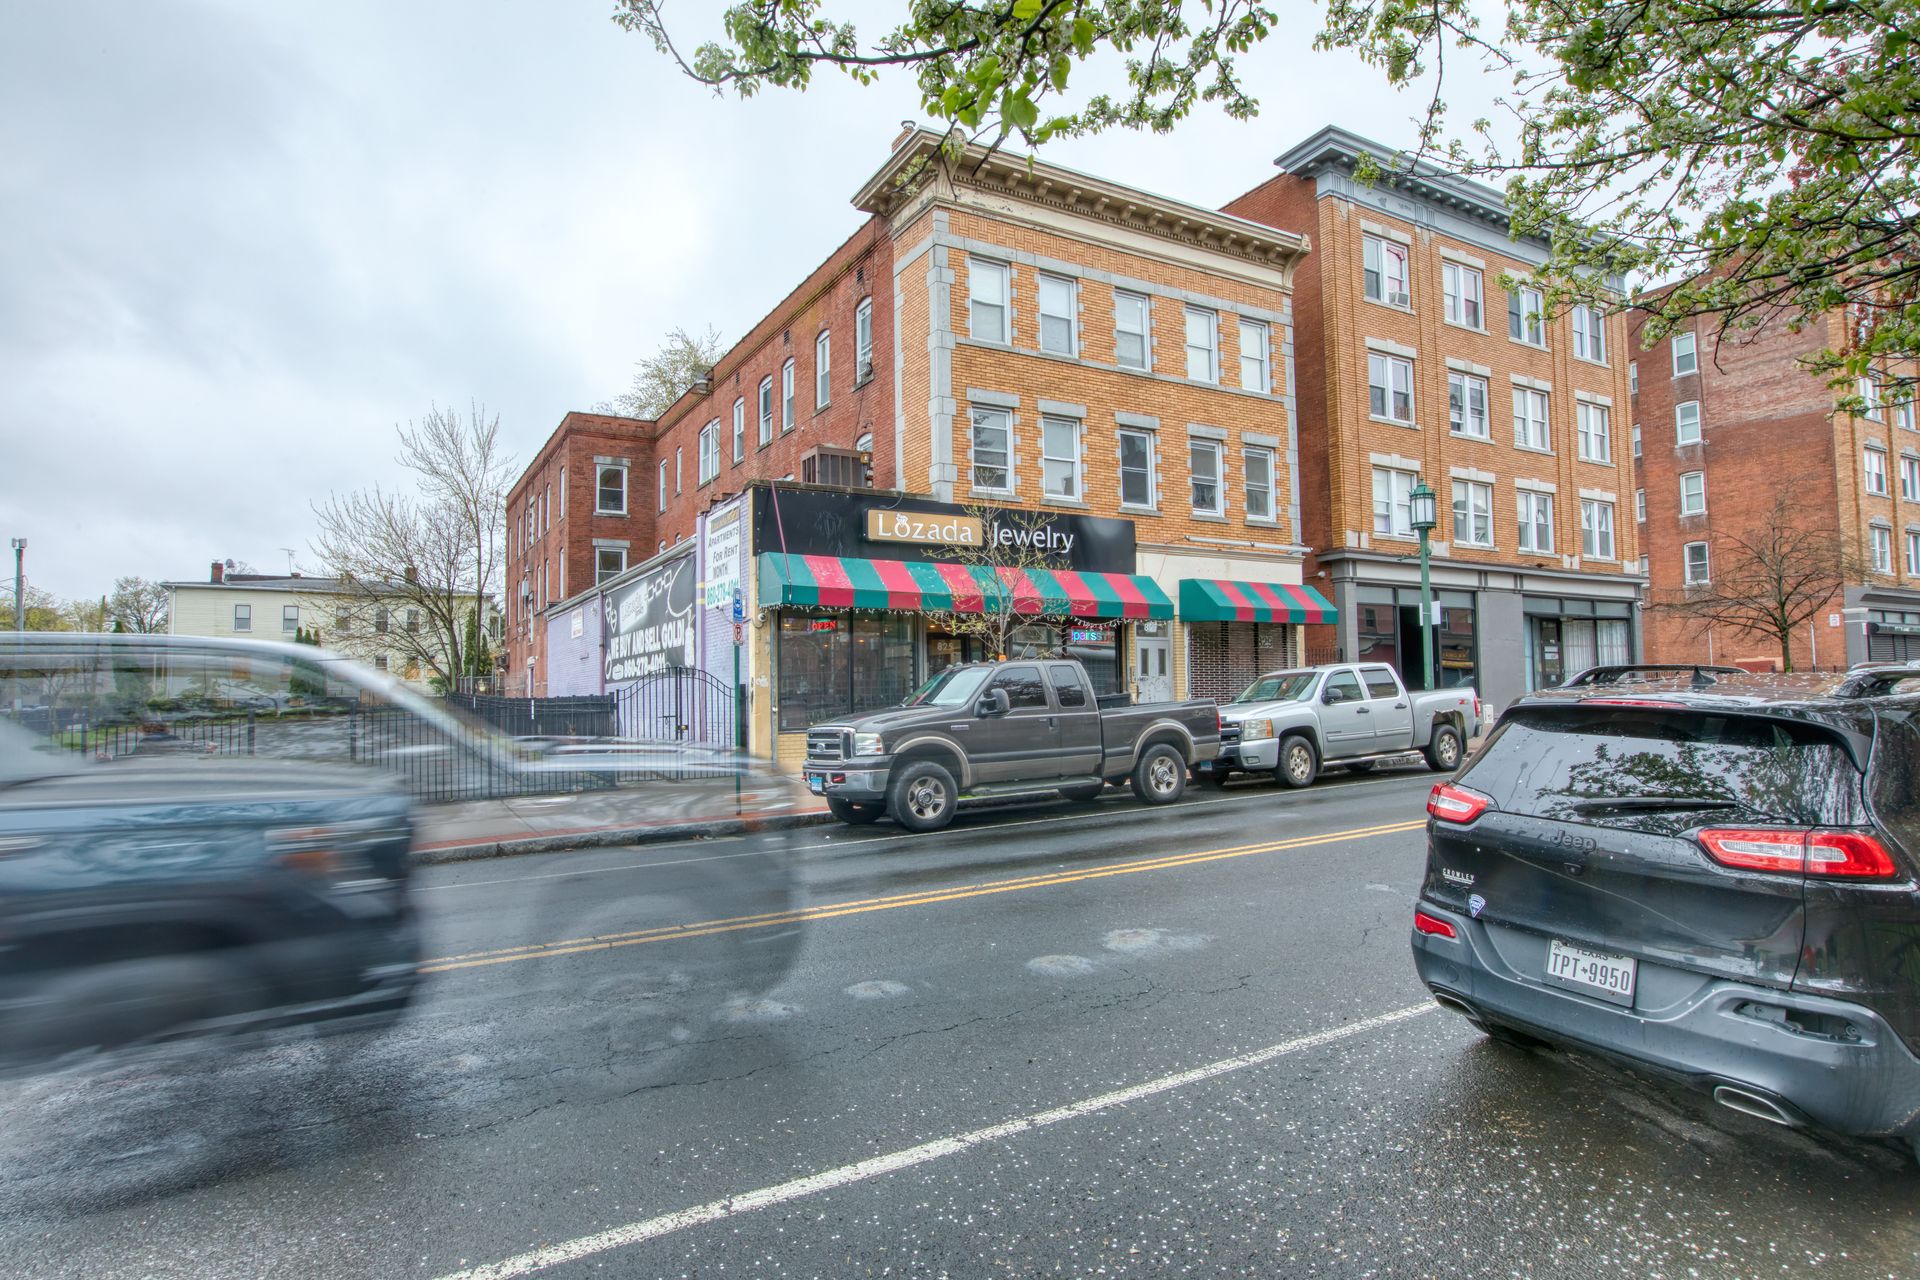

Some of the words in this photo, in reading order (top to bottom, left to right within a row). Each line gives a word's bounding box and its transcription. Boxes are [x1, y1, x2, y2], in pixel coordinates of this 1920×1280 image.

[877, 513, 974, 542] Lozada
[992, 519, 1074, 553] Jewelry
[712, 551, 723, 563] FOR
[723, 544, 739, 559] RENT
[812, 620, 836, 631] OPEN
[610, 636, 620, 660] WE
[619, 633, 632, 659] BUY
[632, 629, 645, 656] AND
[644, 625, 661, 653] SELL
[937, 642, 954, 652] 825
[1551, 830, 1597, 855] Jeep
[1442, 867, 1475, 881] CROWLEY
